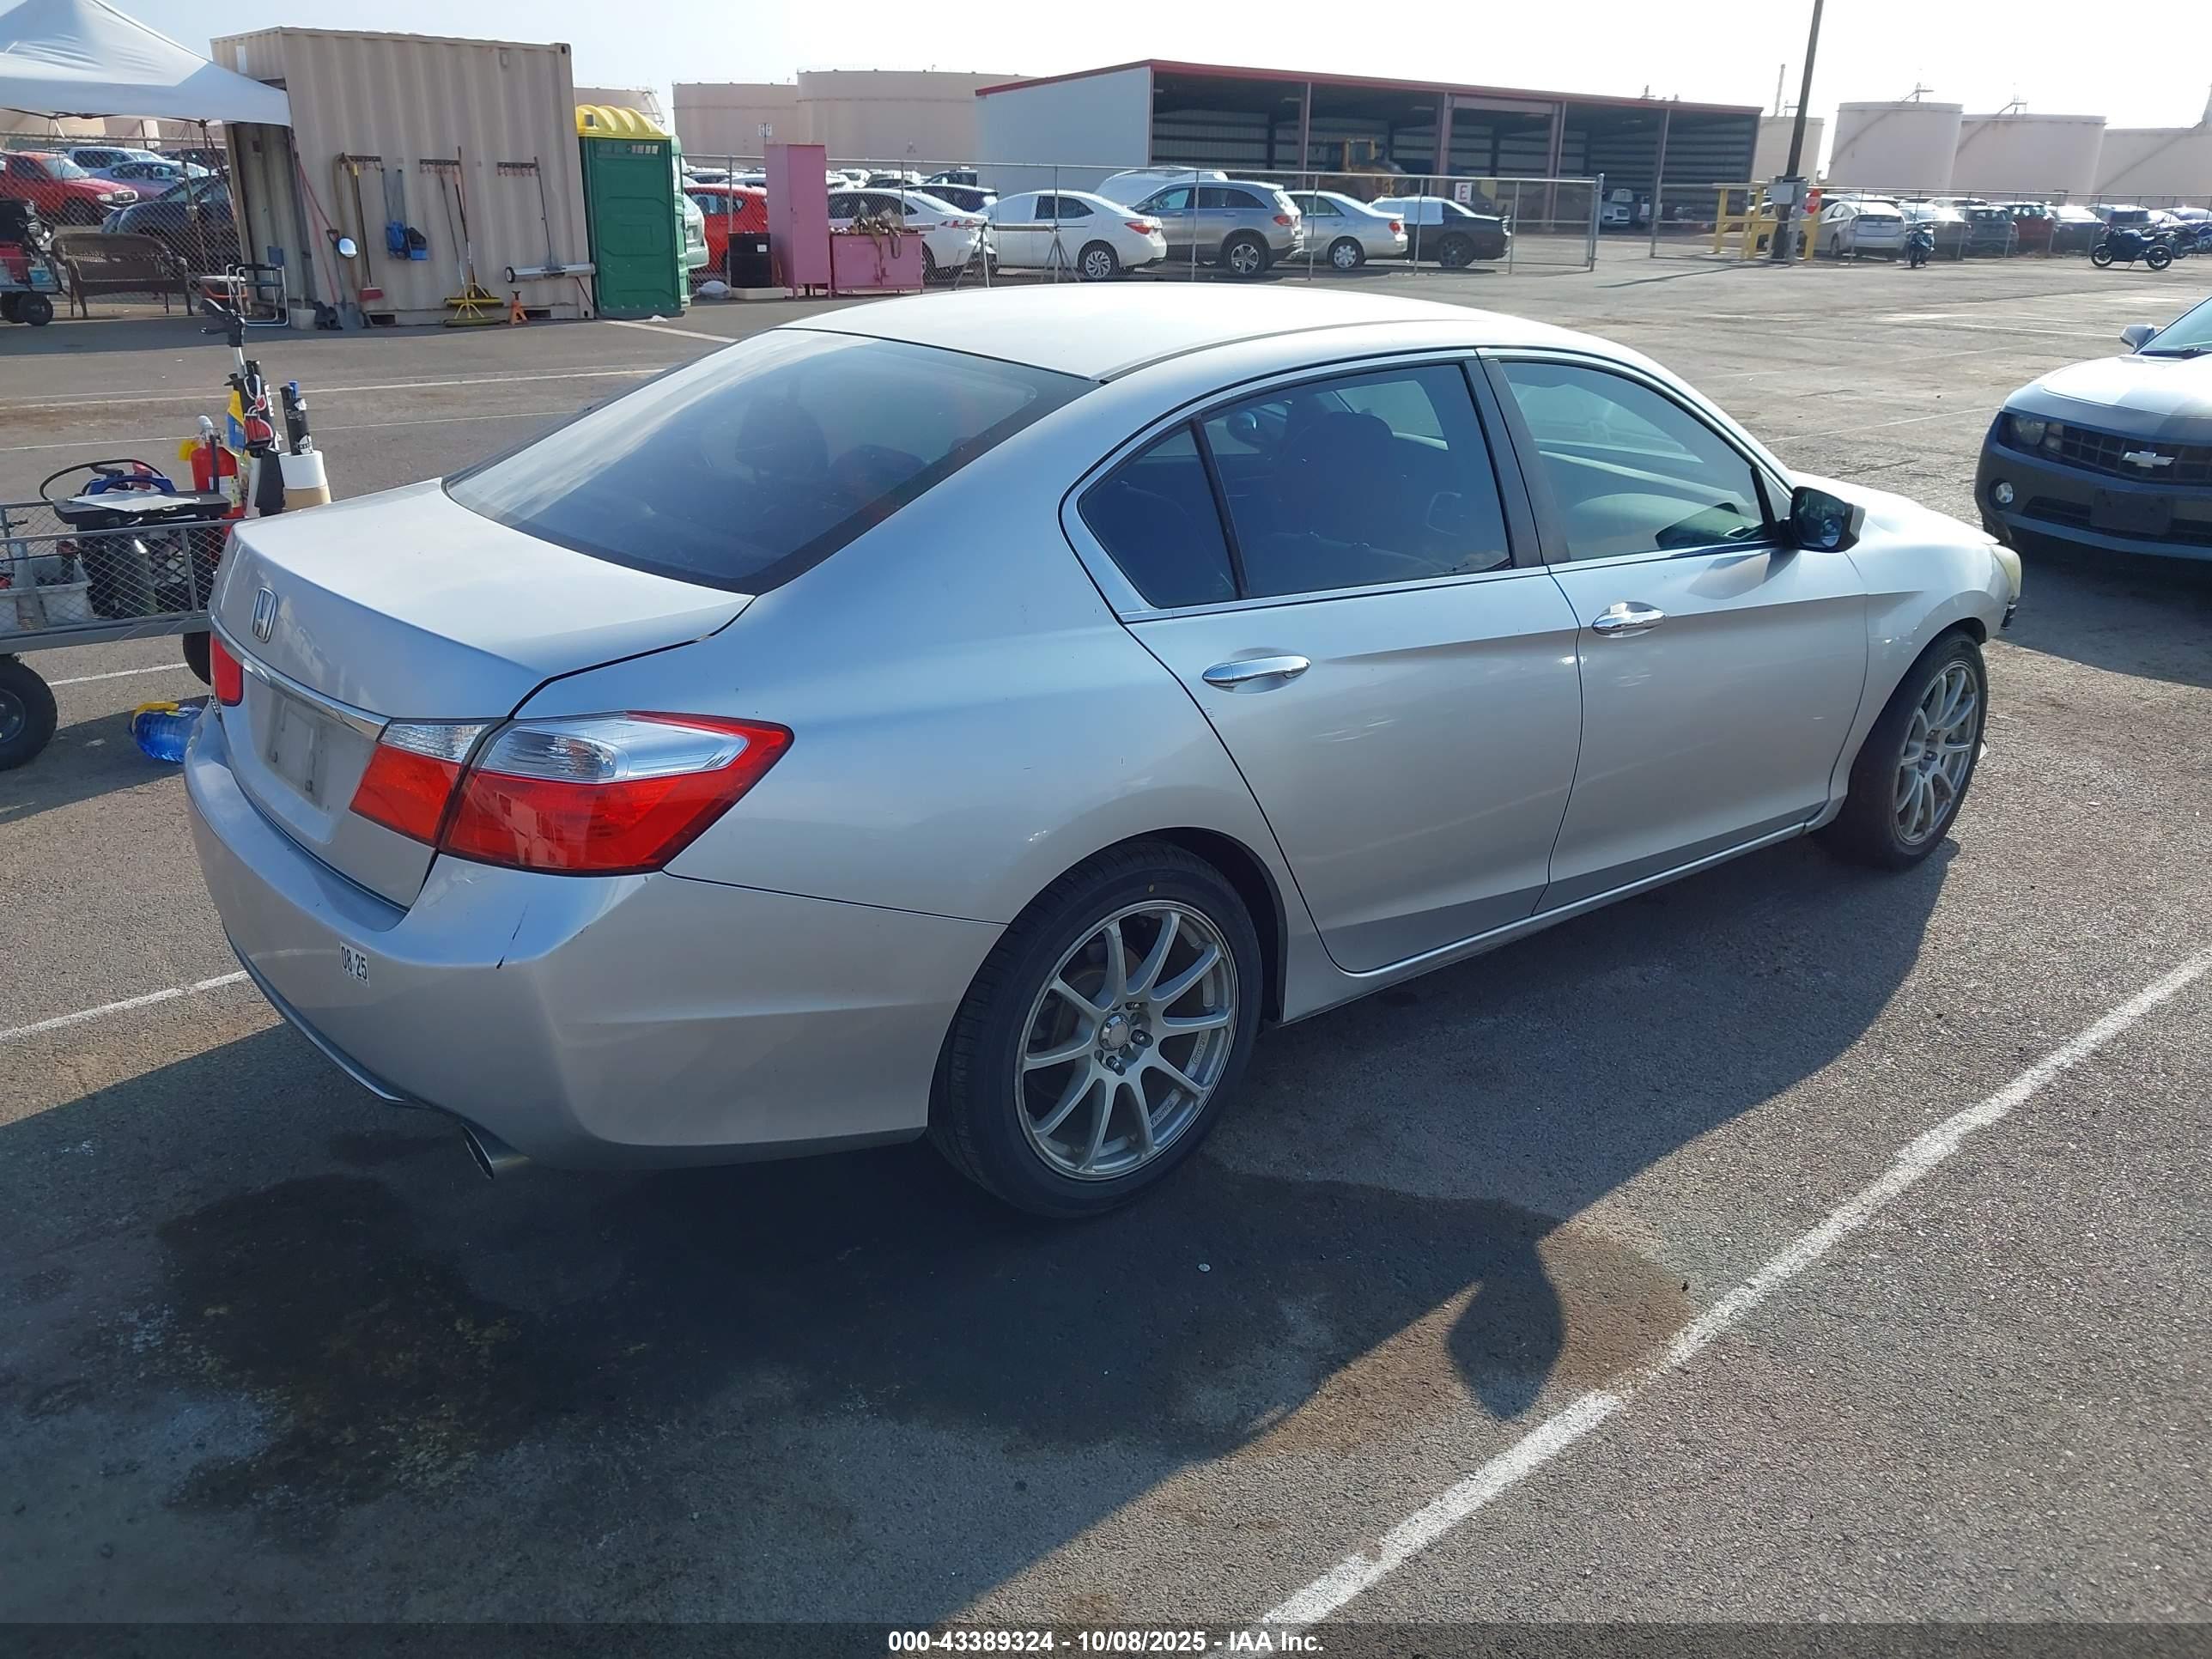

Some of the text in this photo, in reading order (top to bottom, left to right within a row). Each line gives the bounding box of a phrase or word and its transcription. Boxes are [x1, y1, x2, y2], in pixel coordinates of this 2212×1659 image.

[1460, 185, 1468, 200] E
[341, 945, 368, 980] 08 25
